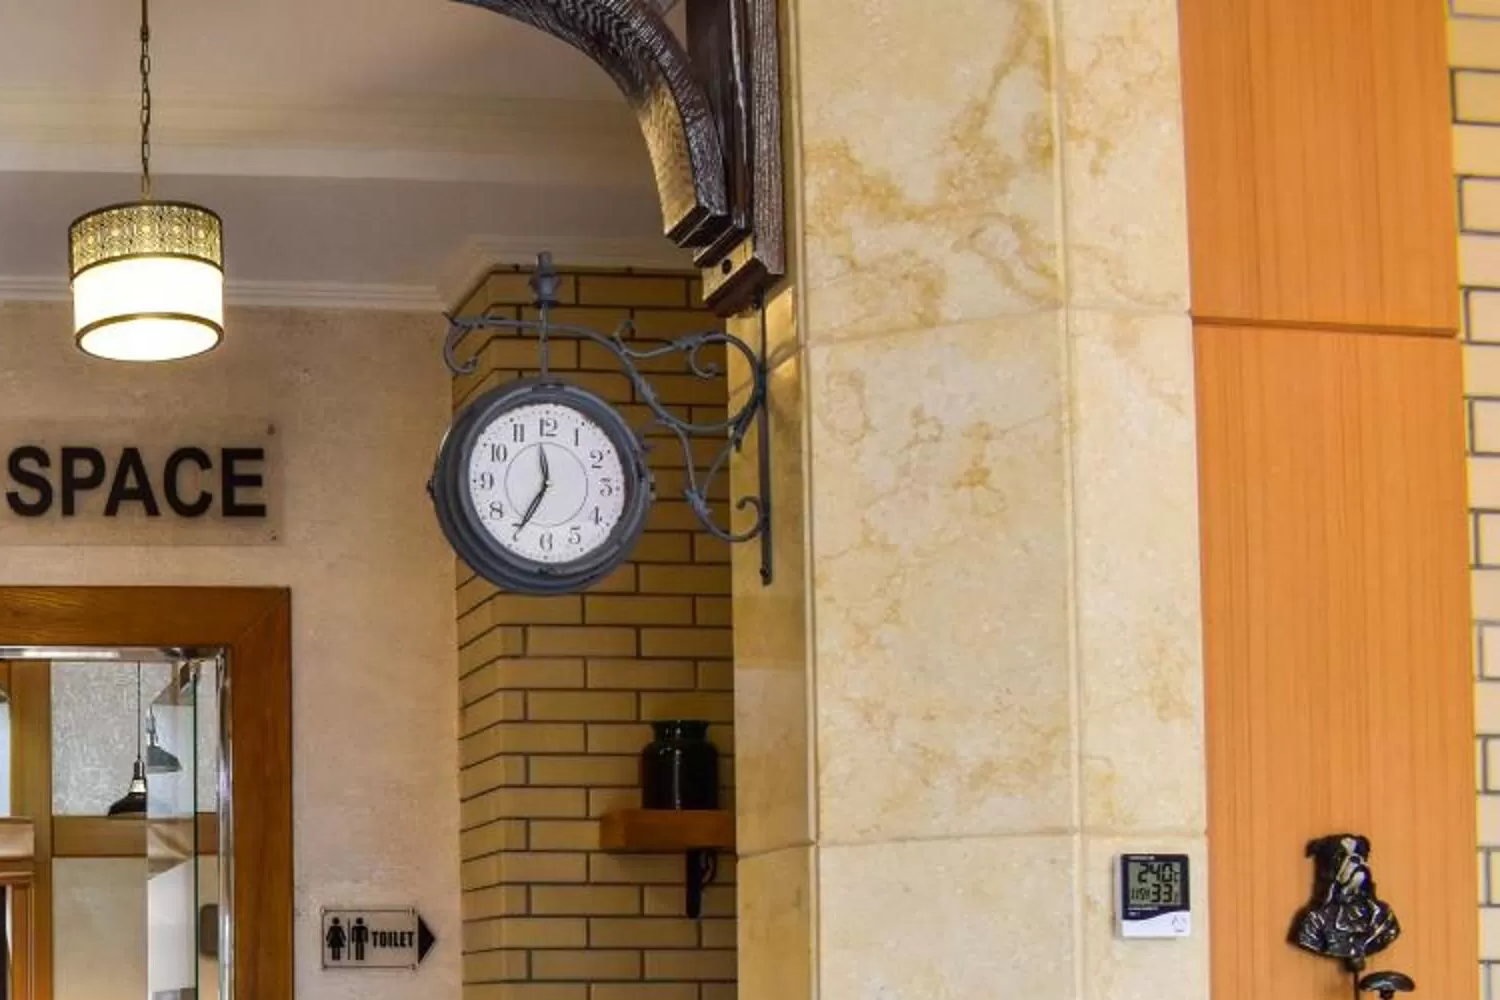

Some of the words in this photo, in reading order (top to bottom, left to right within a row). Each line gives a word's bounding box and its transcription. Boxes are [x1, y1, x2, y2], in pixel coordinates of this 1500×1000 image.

[513, 424, 525, 442] 11
[539, 418, 558, 437] 12
[574, 428, 579, 446] 1
[491, 443, 507, 462] 10
[590, 450, 604, 469] 2
[4, 445, 268, 519] SPACE
[600, 477, 613, 497] 3
[568, 527, 581, 545] 5
[371, 930, 414, 948] TOILET
